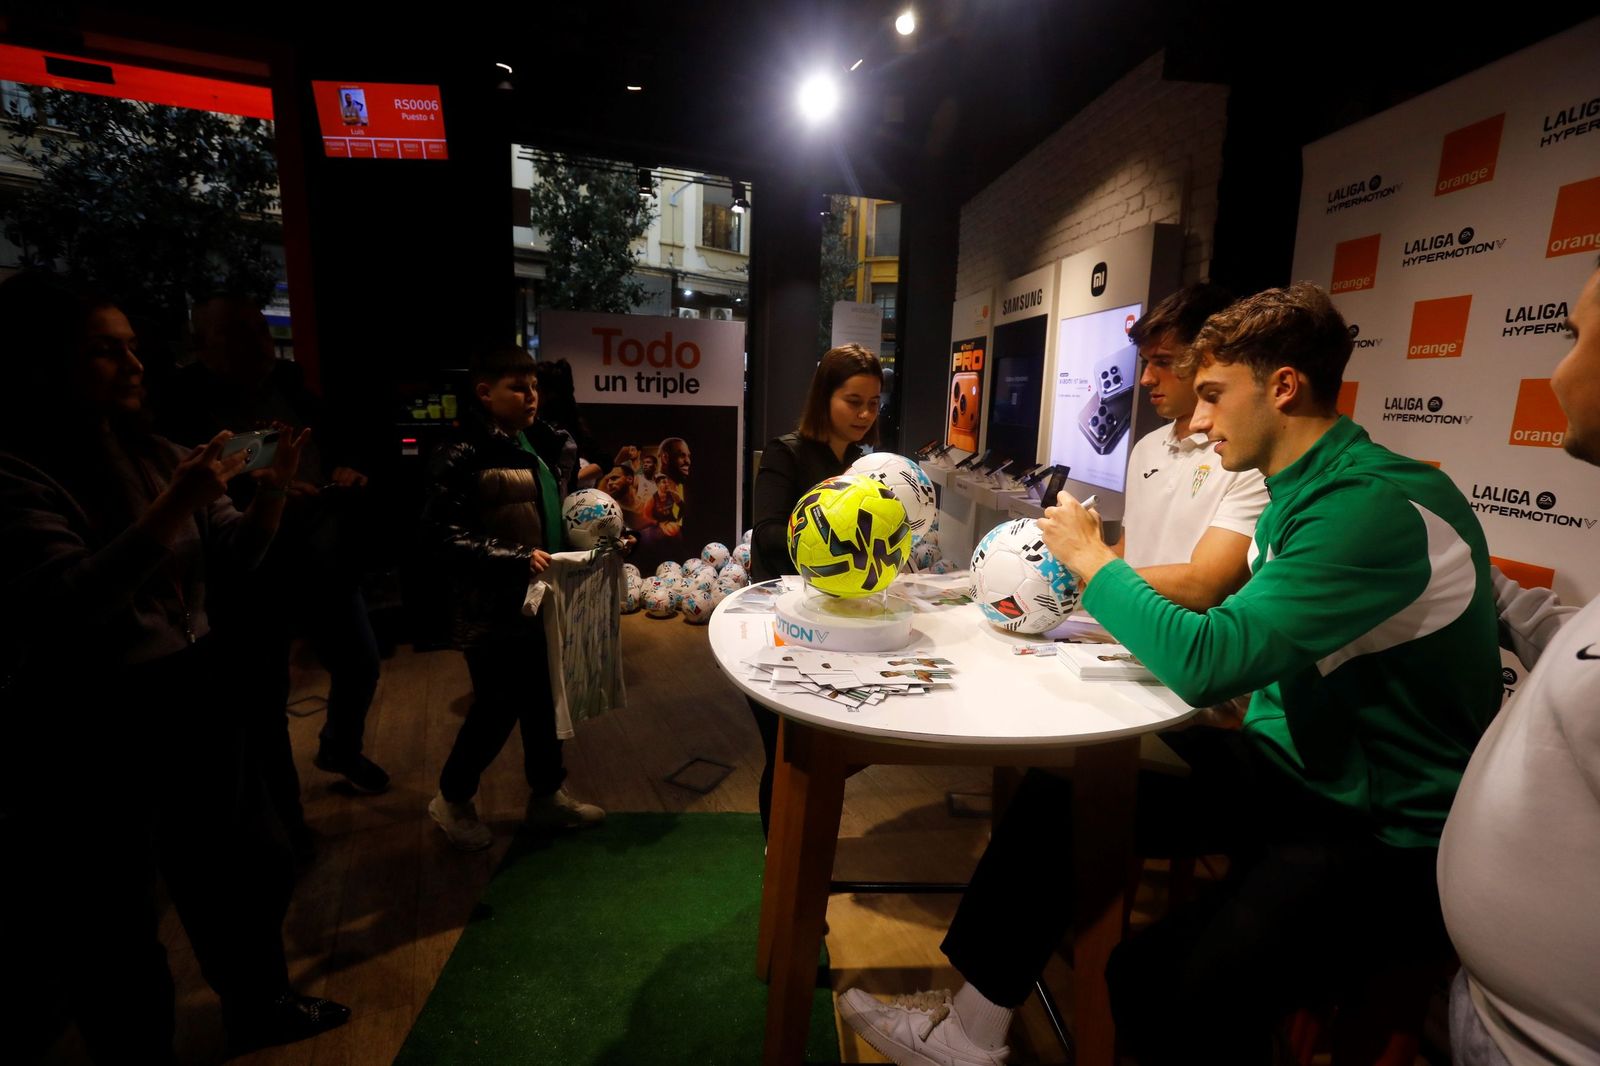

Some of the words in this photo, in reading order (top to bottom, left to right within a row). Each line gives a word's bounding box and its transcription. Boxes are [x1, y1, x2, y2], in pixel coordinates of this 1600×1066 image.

[394, 99, 439, 111] RS0006
[1543, 98, 1600, 131] LALIG
[402, 112, 428, 121] Puesto
[429, 113, 435, 121] 4
[1540, 119, 1600, 148] HYPER
[1438, 167, 1489, 191] orange
[1328, 181, 1365, 204] LALIGA
[1404, 233, 1454, 255] LALIGA
[1332, 277, 1370, 291] orange
[1002, 288, 1043, 316] SAMSUNG
[1505, 302, 1568, 324] LALIGA
[1502, 322, 1569, 337] HYPERM
[592, 327, 700, 369] Todo
[1410, 343, 1457, 357] orange
[952, 349, 984, 372] PRO
[594, 375, 627, 392] un
[635, 371, 700, 398] triple
[1385, 397, 1423, 411] LALIGA
[1513, 430, 1565, 446] orang
[1472, 484, 1530, 506] LALIGA
